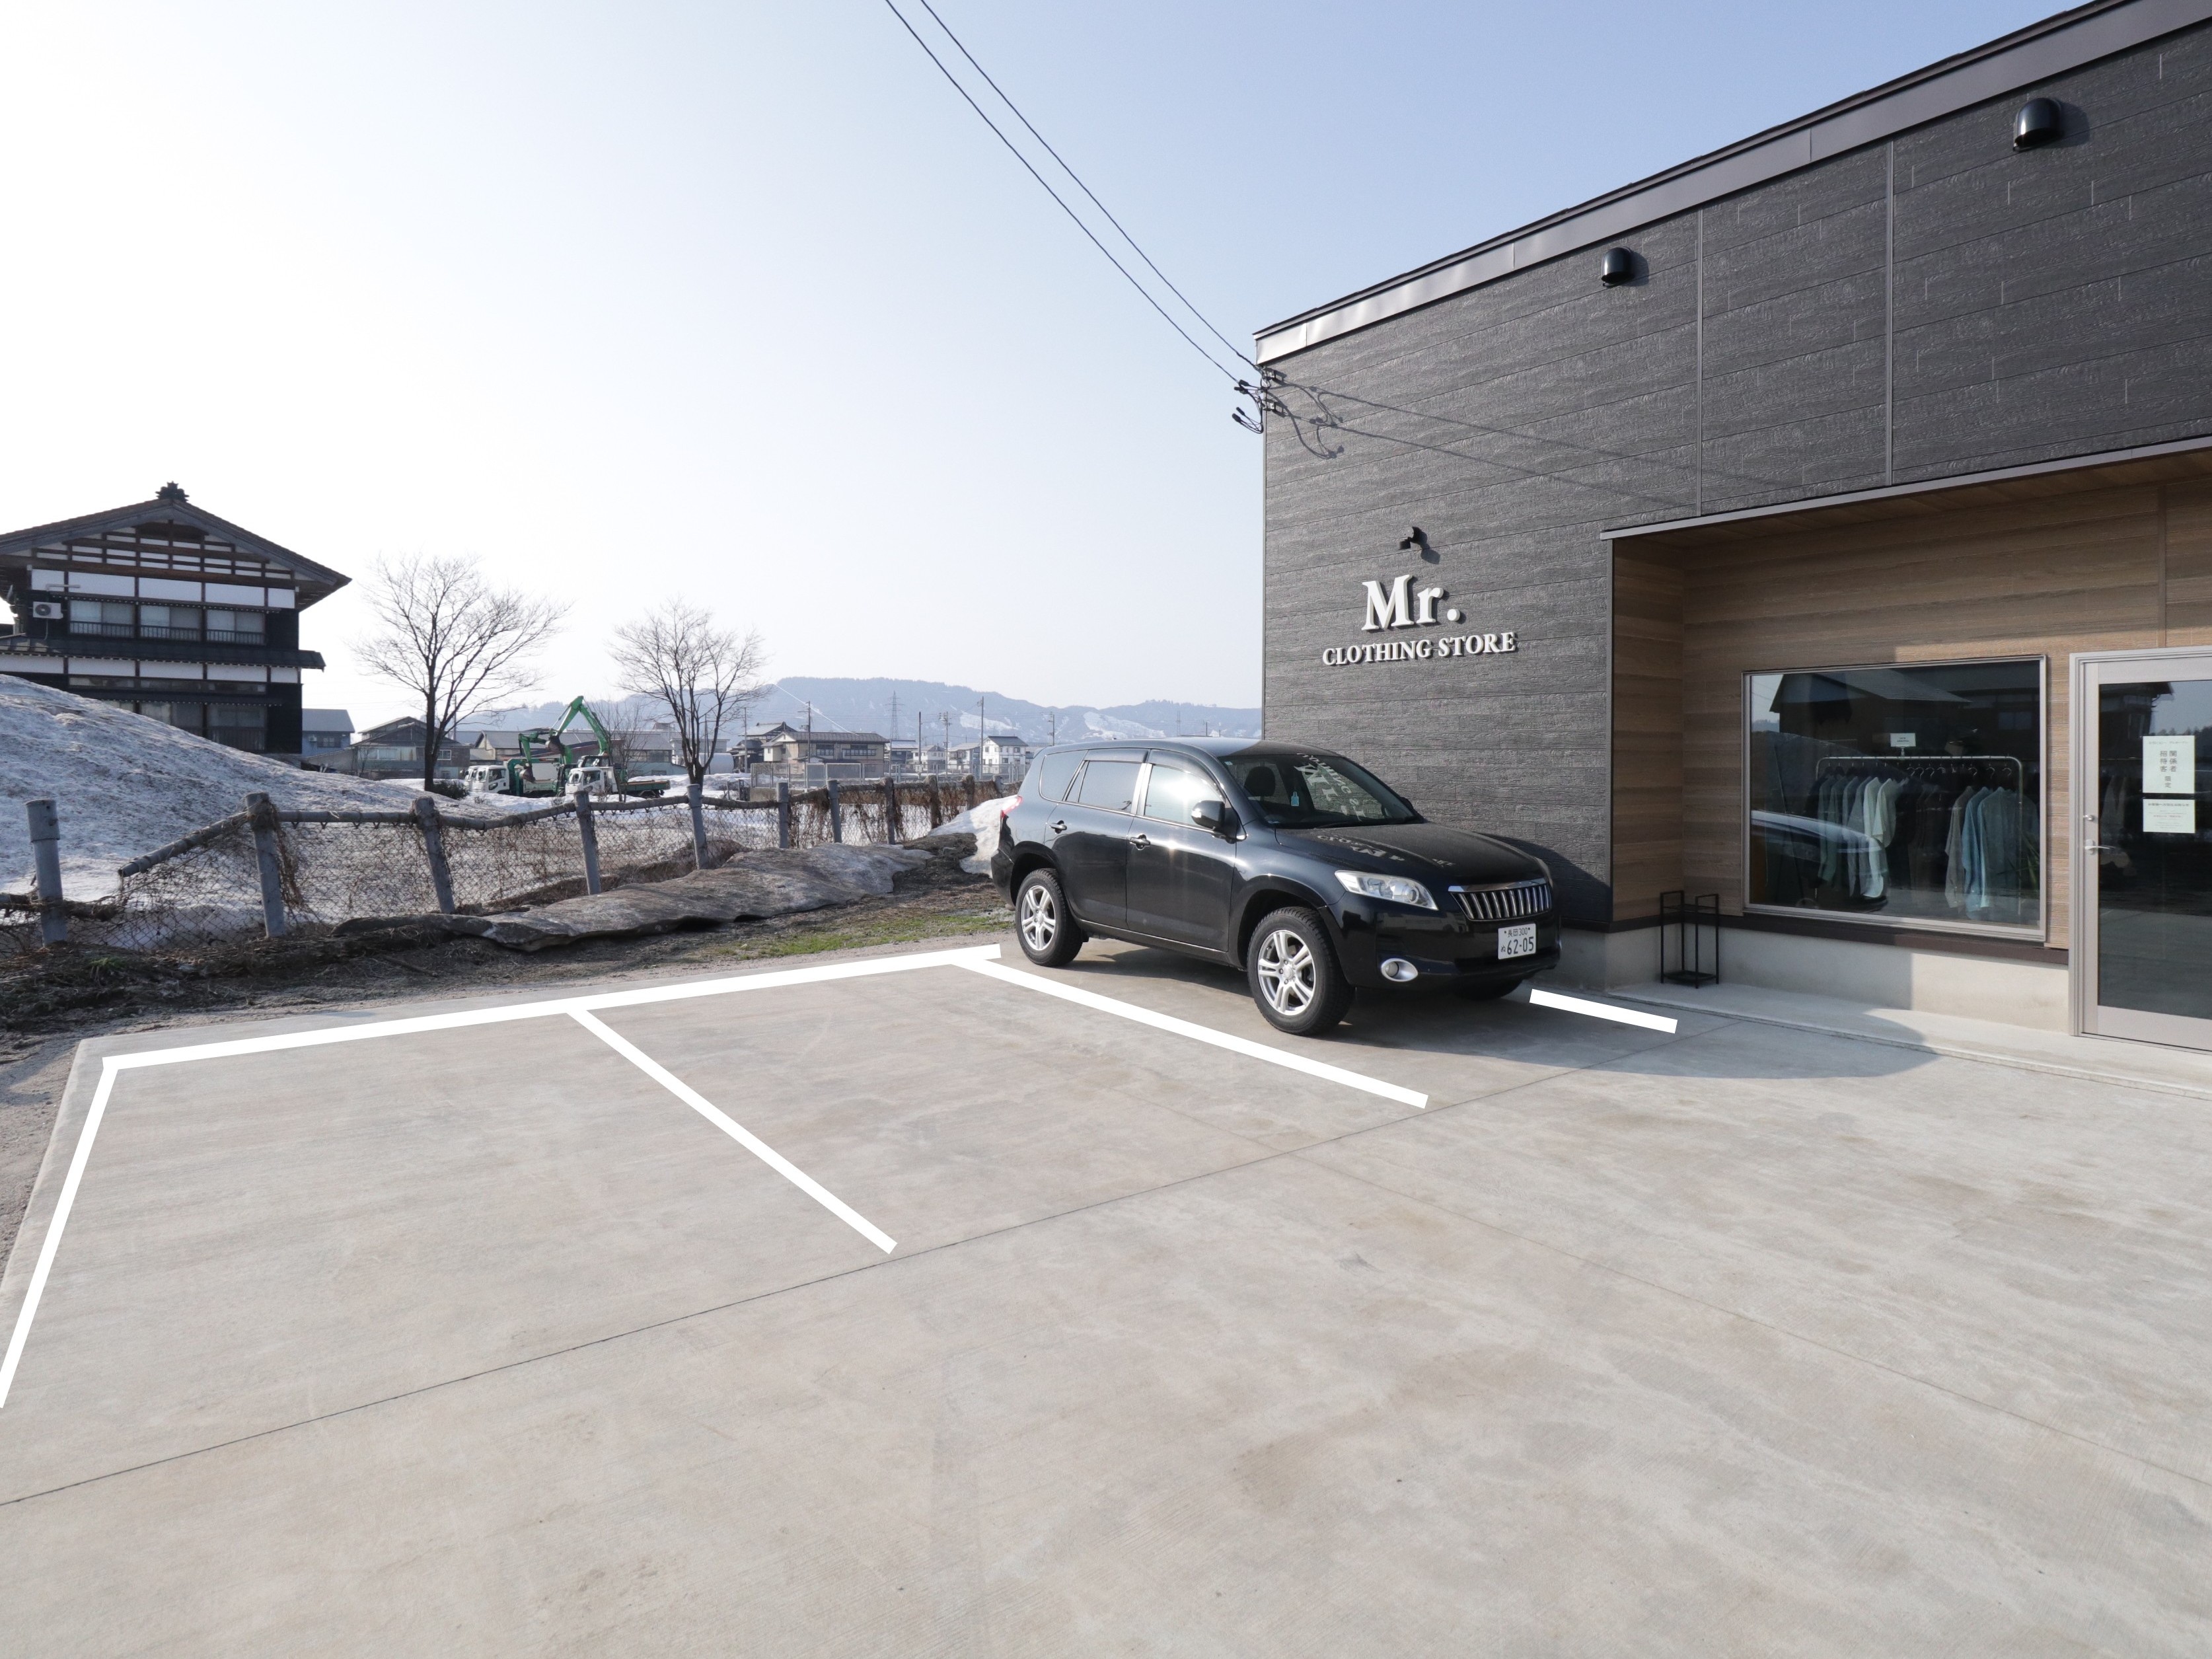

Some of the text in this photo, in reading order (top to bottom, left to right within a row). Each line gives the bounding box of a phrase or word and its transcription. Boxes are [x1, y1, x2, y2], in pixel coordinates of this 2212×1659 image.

[1361, 574, 1460, 630] Mr.
[1322, 632, 1516, 665] CLOTHING STORE
